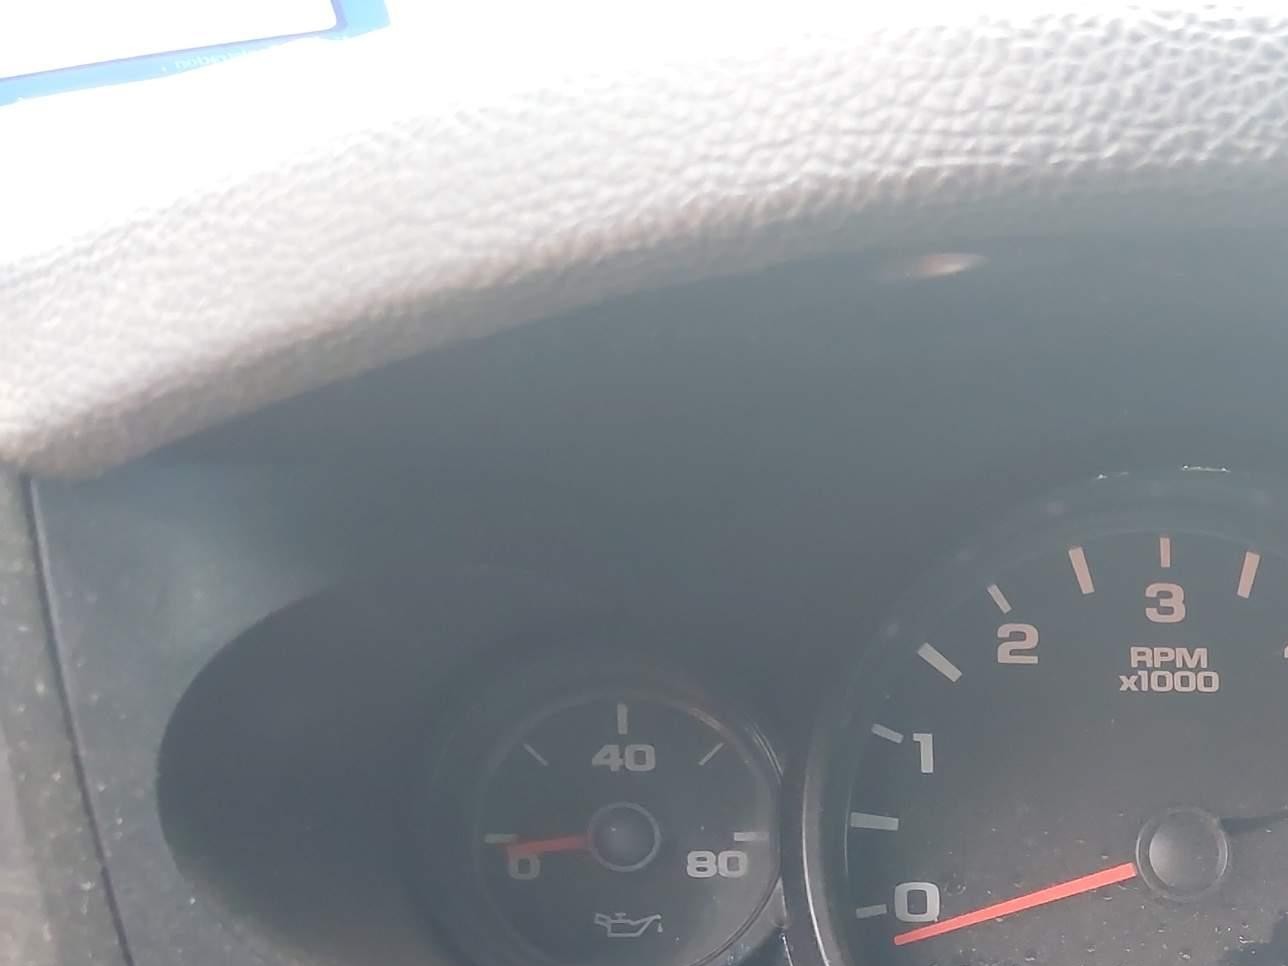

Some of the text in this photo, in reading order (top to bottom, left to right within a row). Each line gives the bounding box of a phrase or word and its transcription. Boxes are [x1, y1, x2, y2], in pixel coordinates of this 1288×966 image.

[1145, 582, 1186, 623] 3
[996, 623, 1039, 665] 2
[1130, 646, 1208, 669] RPM
[1119, 670, 1220, 693] x1000
[592, 744, 656, 772] 40
[913, 733, 935, 774] 1
[686, 850, 748, 878] 80
[894, 881, 940, 923] 0
